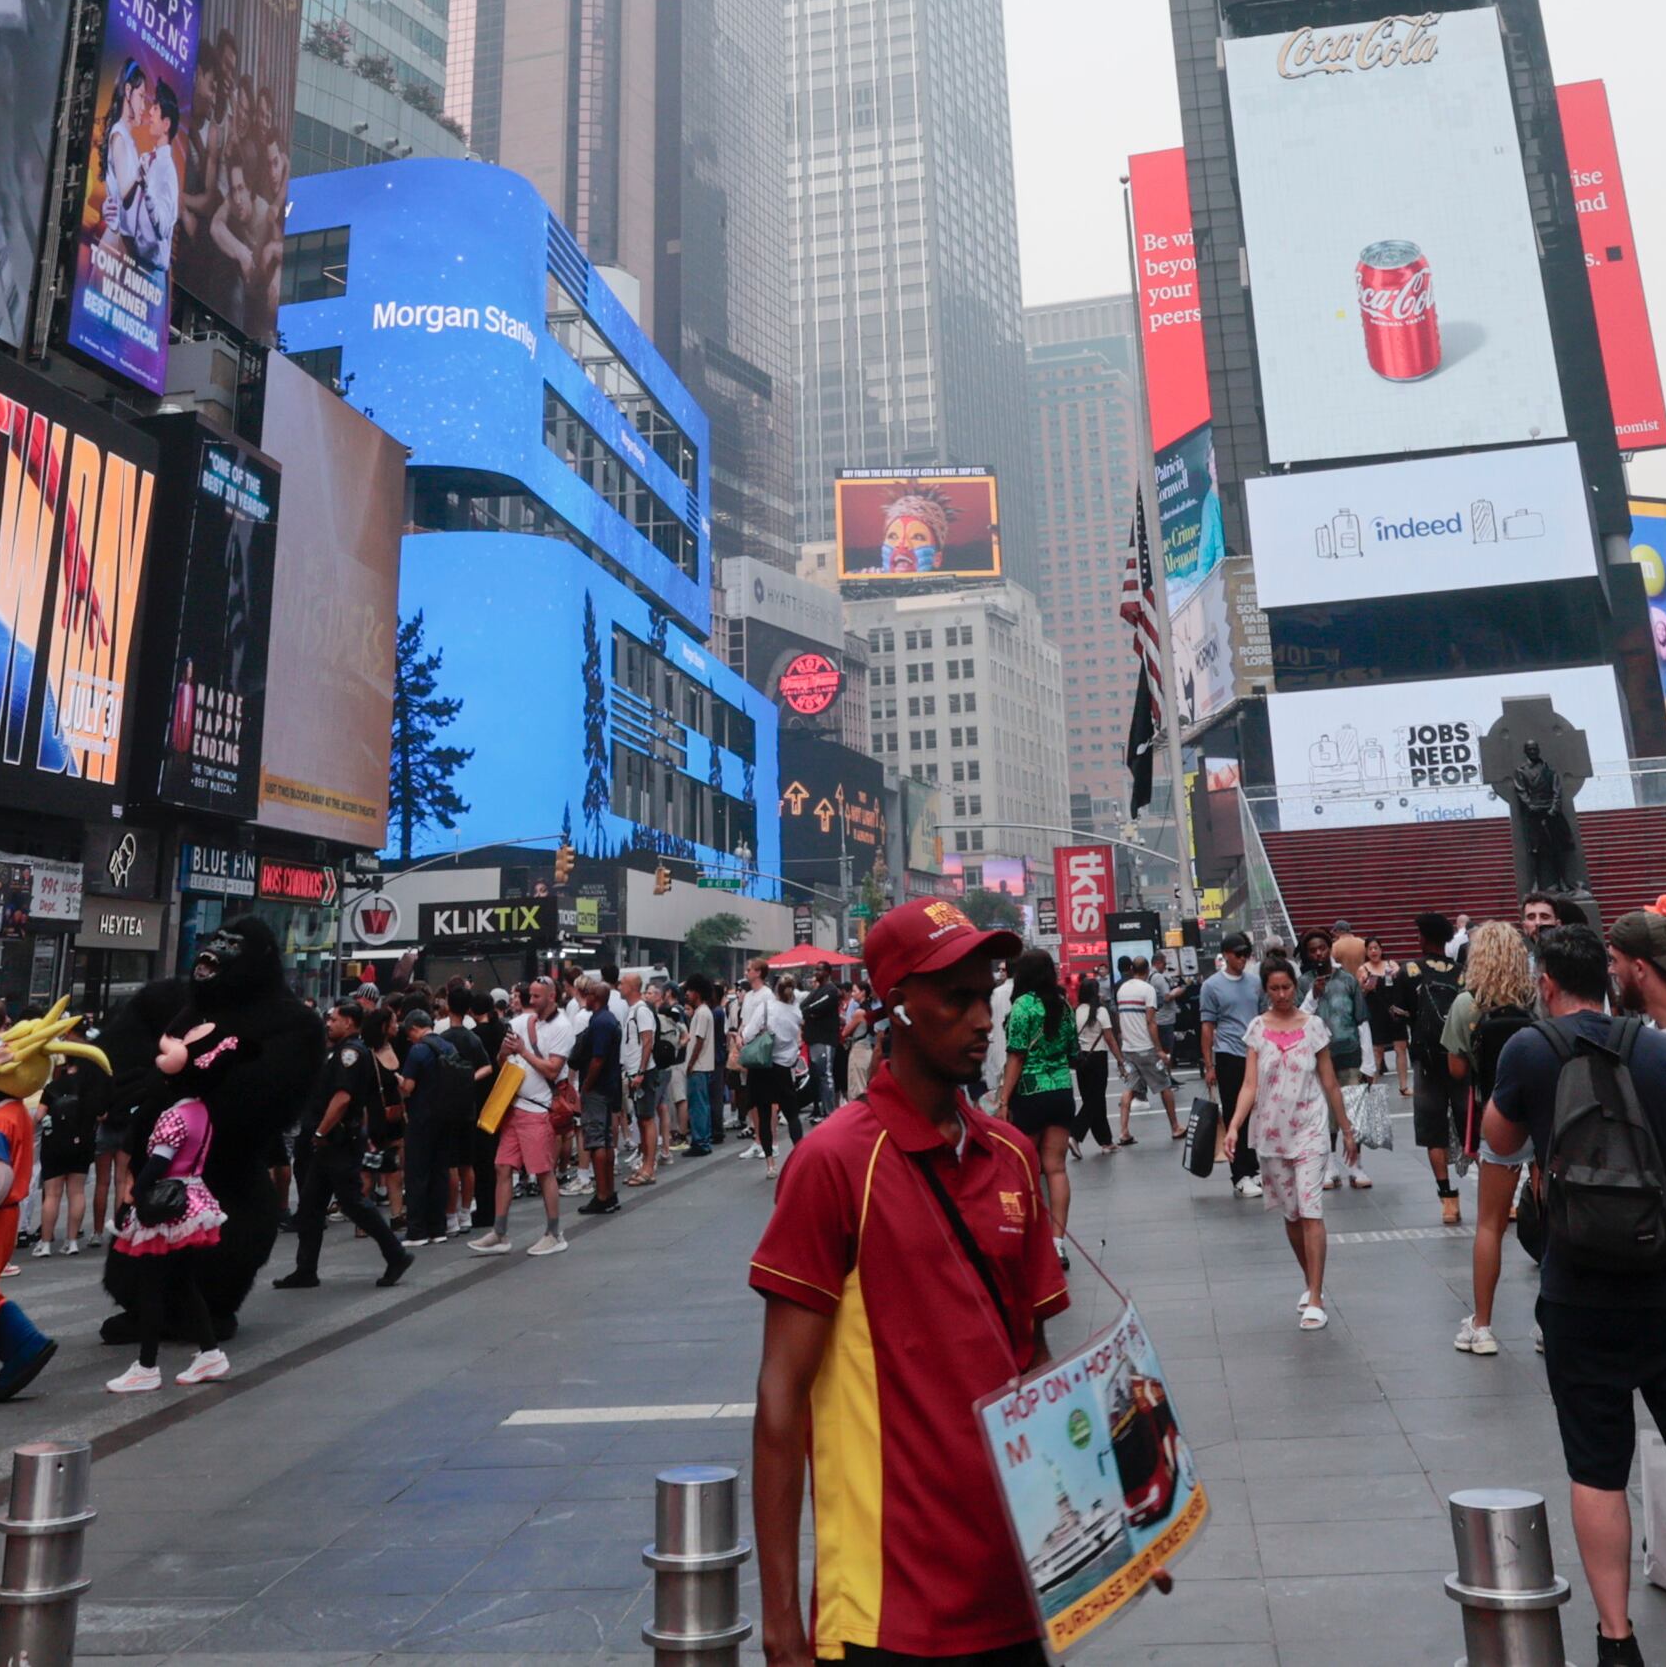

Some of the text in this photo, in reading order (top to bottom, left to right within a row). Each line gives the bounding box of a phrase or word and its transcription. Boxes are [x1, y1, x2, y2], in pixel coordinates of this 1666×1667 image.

[141, 31, 180, 70] BROADWAY
[1276, 12, 1444, 79] Coca-Cola
[1142, 233, 1168, 252] Be
[90, 243, 164, 307] TONY AWARD
[102, 276, 148, 323] WINNER
[1147, 282, 1193, 307] your
[84, 288, 112, 323] BEST
[112, 307, 159, 353] MUSICAL
[373, 300, 538, 360] Morgan Stanley
[1149, 307, 1202, 333] peers
[231, 465, 244, 485] OF
[245, 472, 261, 496] THE
[1155, 454, 1184, 483] Patricia
[202, 470, 237, 505] BEST IN
[1172, 523, 1200, 547] Crime
[1375, 511, 1463, 542] indeed
[36, 432, 155, 786] DAY
[766, 588, 797, 612] HYATT
[60, 683, 122, 740] JULY 31
[196, 683, 244, 718] MAYBE
[195, 708, 242, 741] HAPPY
[1408, 723, 1471, 746] JOBS
[192, 734, 240, 767] ENDING
[1409, 744, 1471, 767] NEED
[192, 846, 227, 875] BLUE
[1069, 851, 1105, 933] tkts
[99, 914, 143, 937] HEYTEA
[434, 905, 541, 936] KLIKTIX
[1001, 1388, 1040, 1427] HOP
[1044, 1372, 1071, 1405] ON
[1055, 1576, 1127, 1643] PURCHASE
[1151, 1520, 1190, 1567] TICKETS
